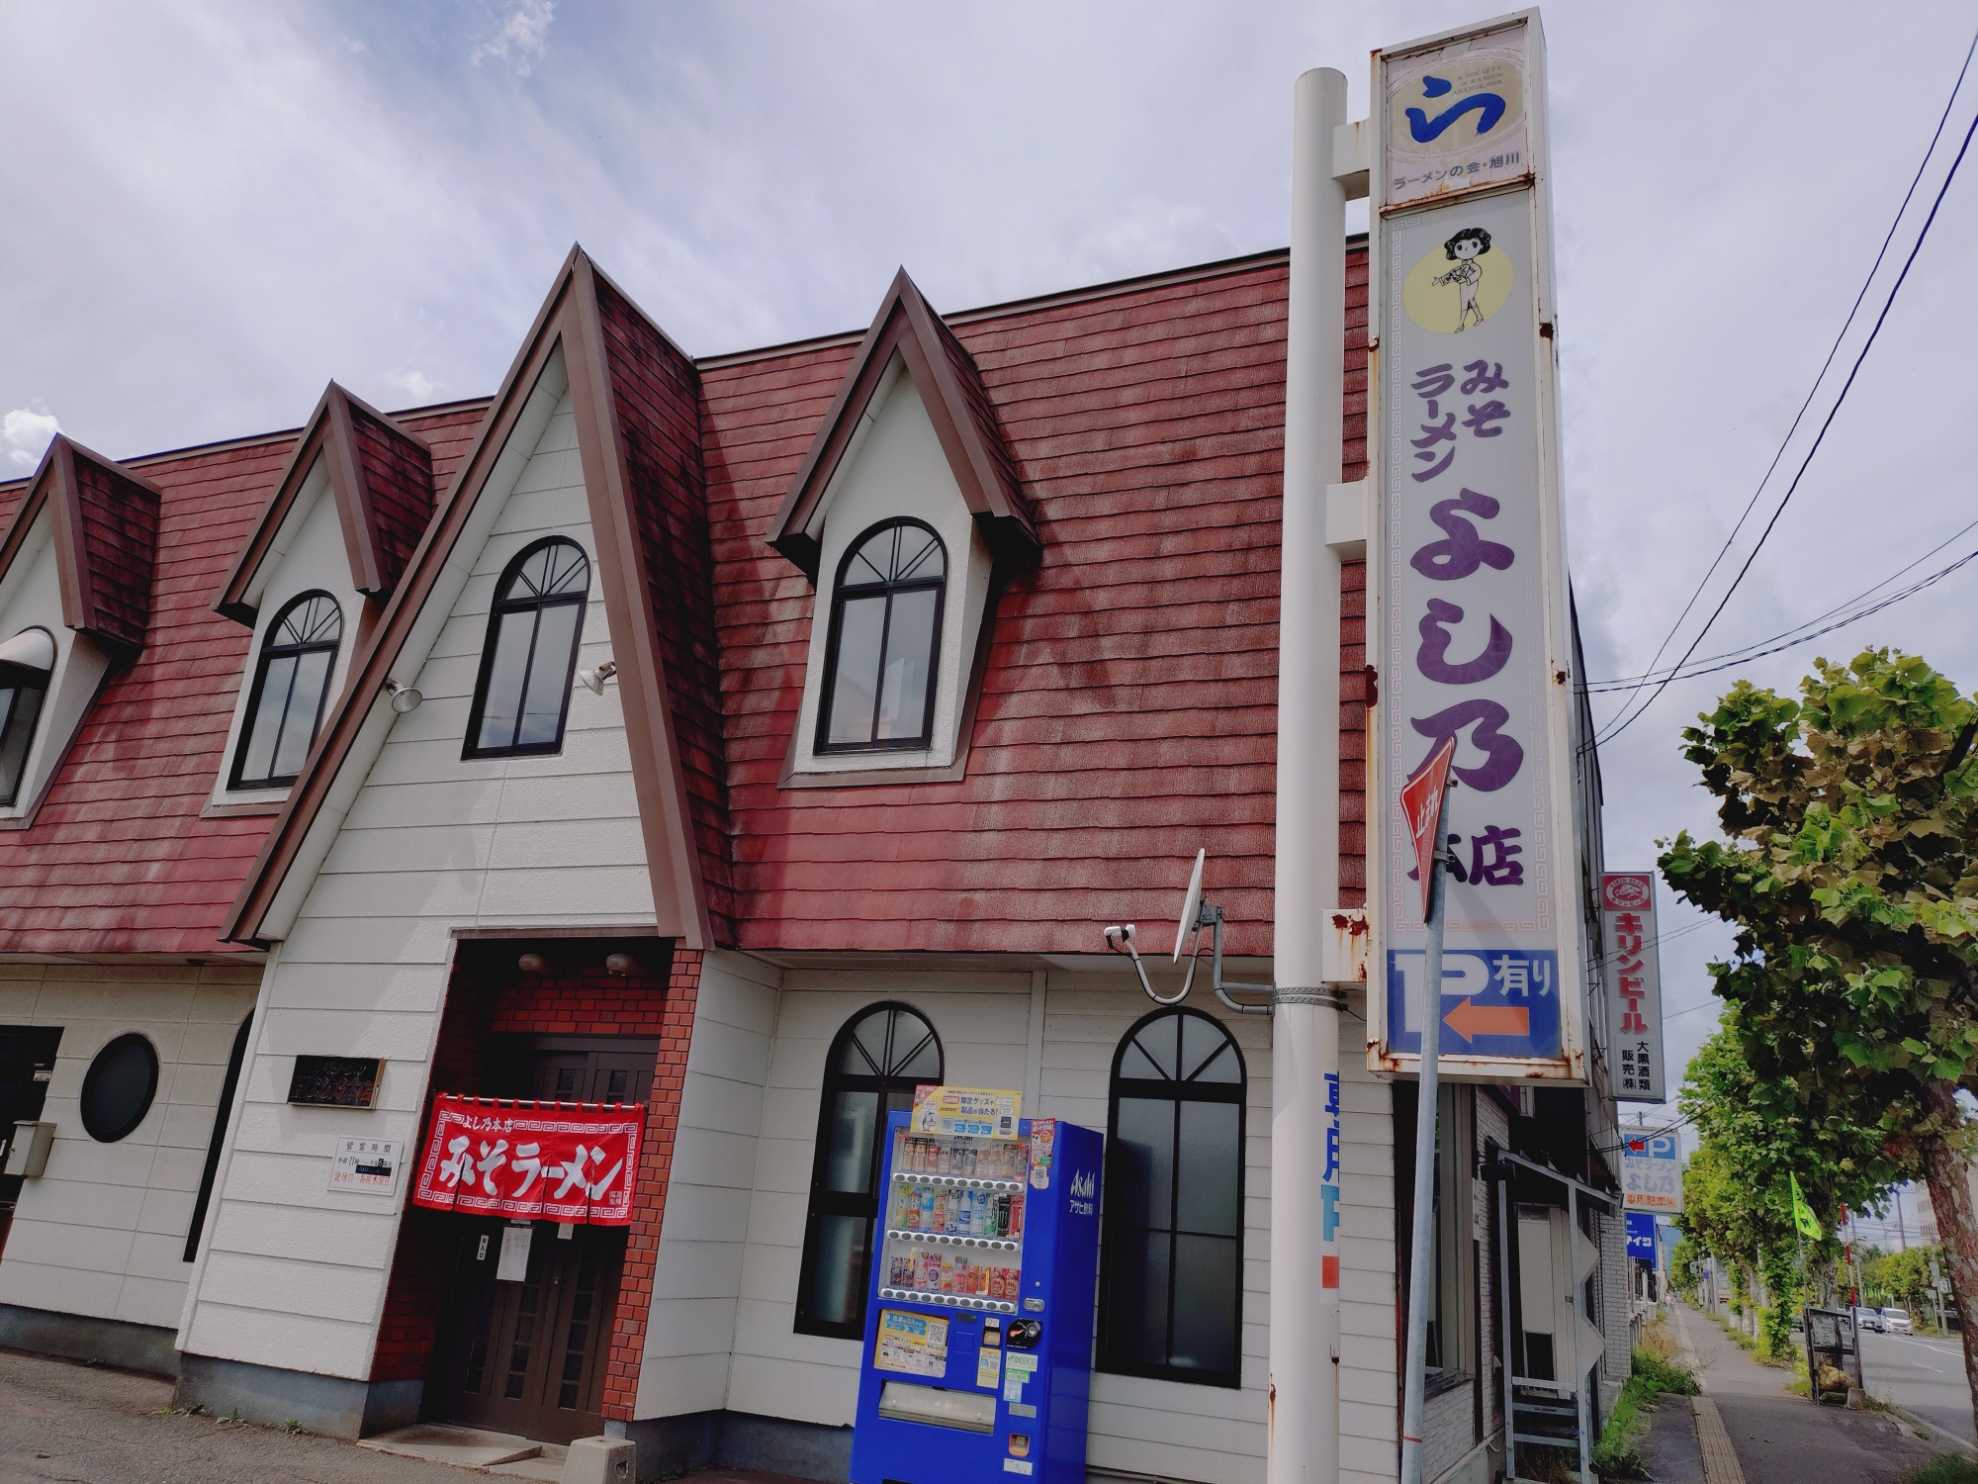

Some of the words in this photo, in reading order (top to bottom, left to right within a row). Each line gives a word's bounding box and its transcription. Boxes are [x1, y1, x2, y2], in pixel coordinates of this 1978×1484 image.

[1615, 912, 1648, 1036] キリンビール
[463, 1115, 514, 1133] よし乃本店
[439, 1135, 623, 1201] みそラーメン
